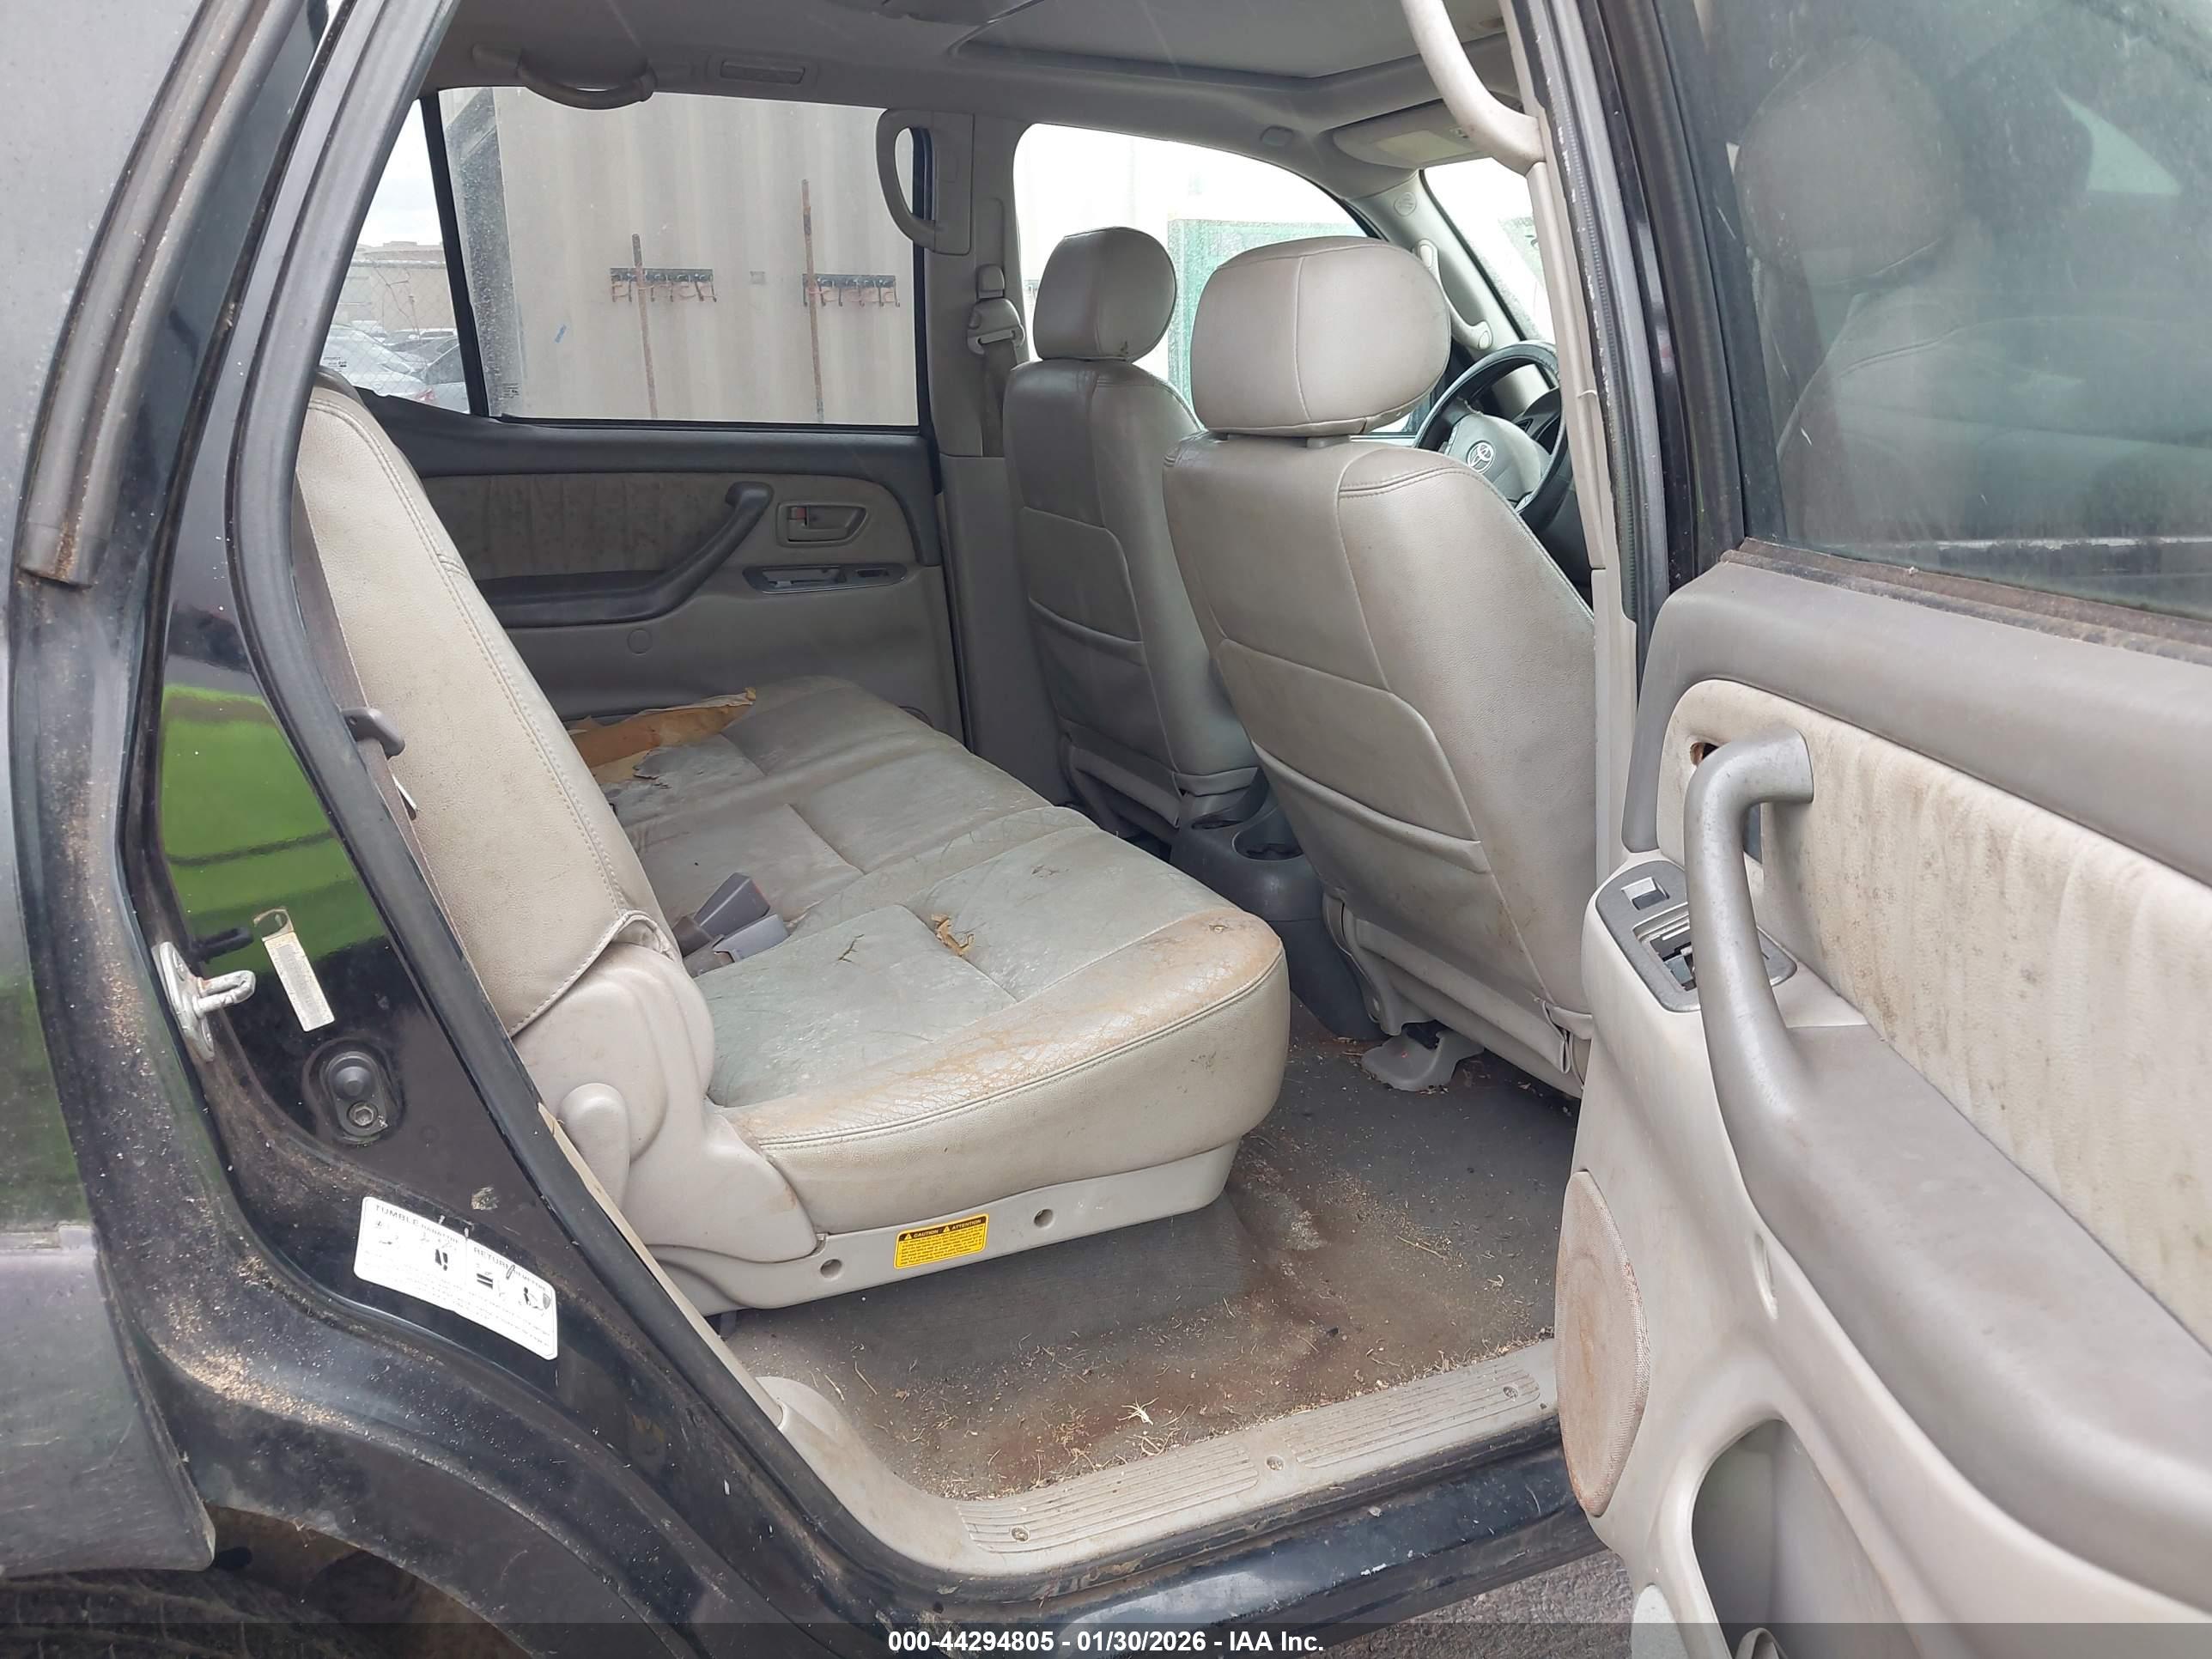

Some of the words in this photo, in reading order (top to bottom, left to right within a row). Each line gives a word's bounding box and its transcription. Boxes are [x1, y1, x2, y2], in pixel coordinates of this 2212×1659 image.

[376, 1204, 419, 1227] TUMBLE
[913, 1229, 939, 1238] CAUTION
[951, 1219, 981, 1231] ATTENTION
